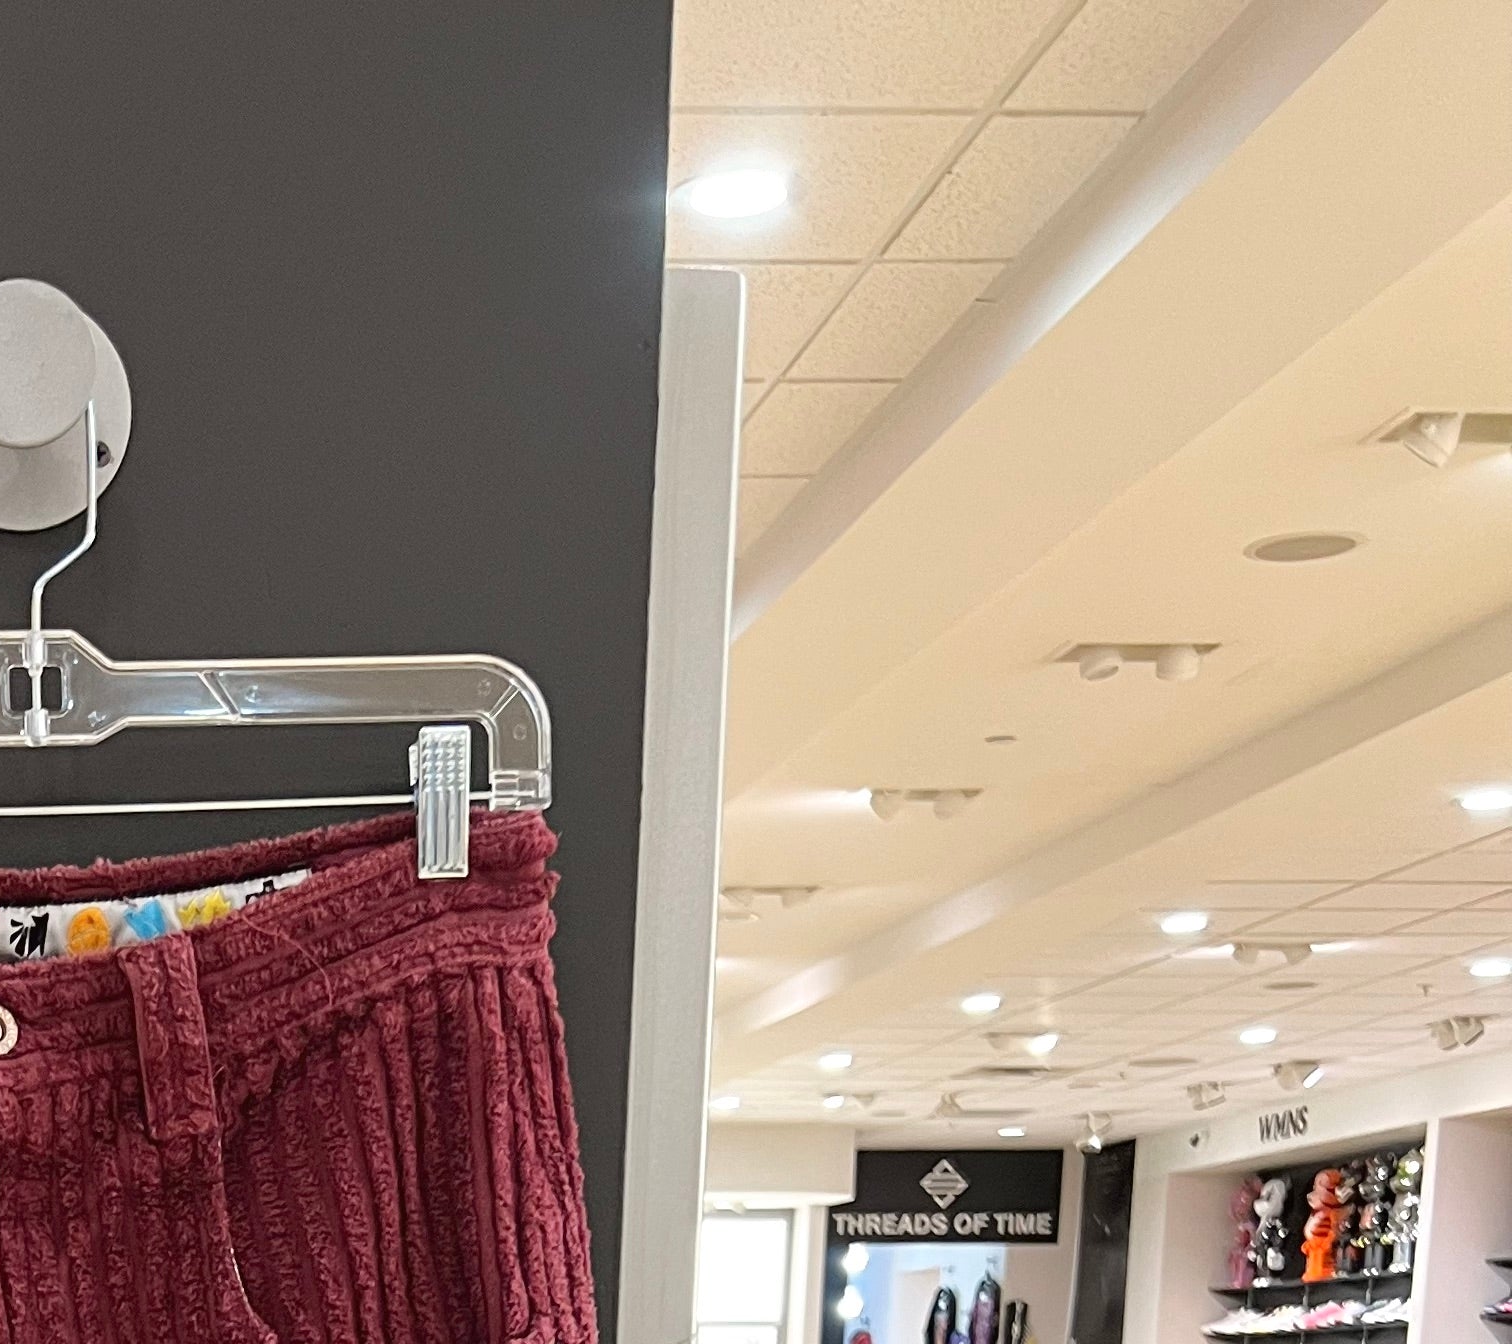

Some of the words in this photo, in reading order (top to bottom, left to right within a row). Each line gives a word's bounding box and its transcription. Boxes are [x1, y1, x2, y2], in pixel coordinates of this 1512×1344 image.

[1258, 1105, 1308, 1143] WMNS
[832, 1213, 949, 1236] THREADS
[953, 1212, 990, 1236] OF
[993, 1212, 1053, 1236] TIME
